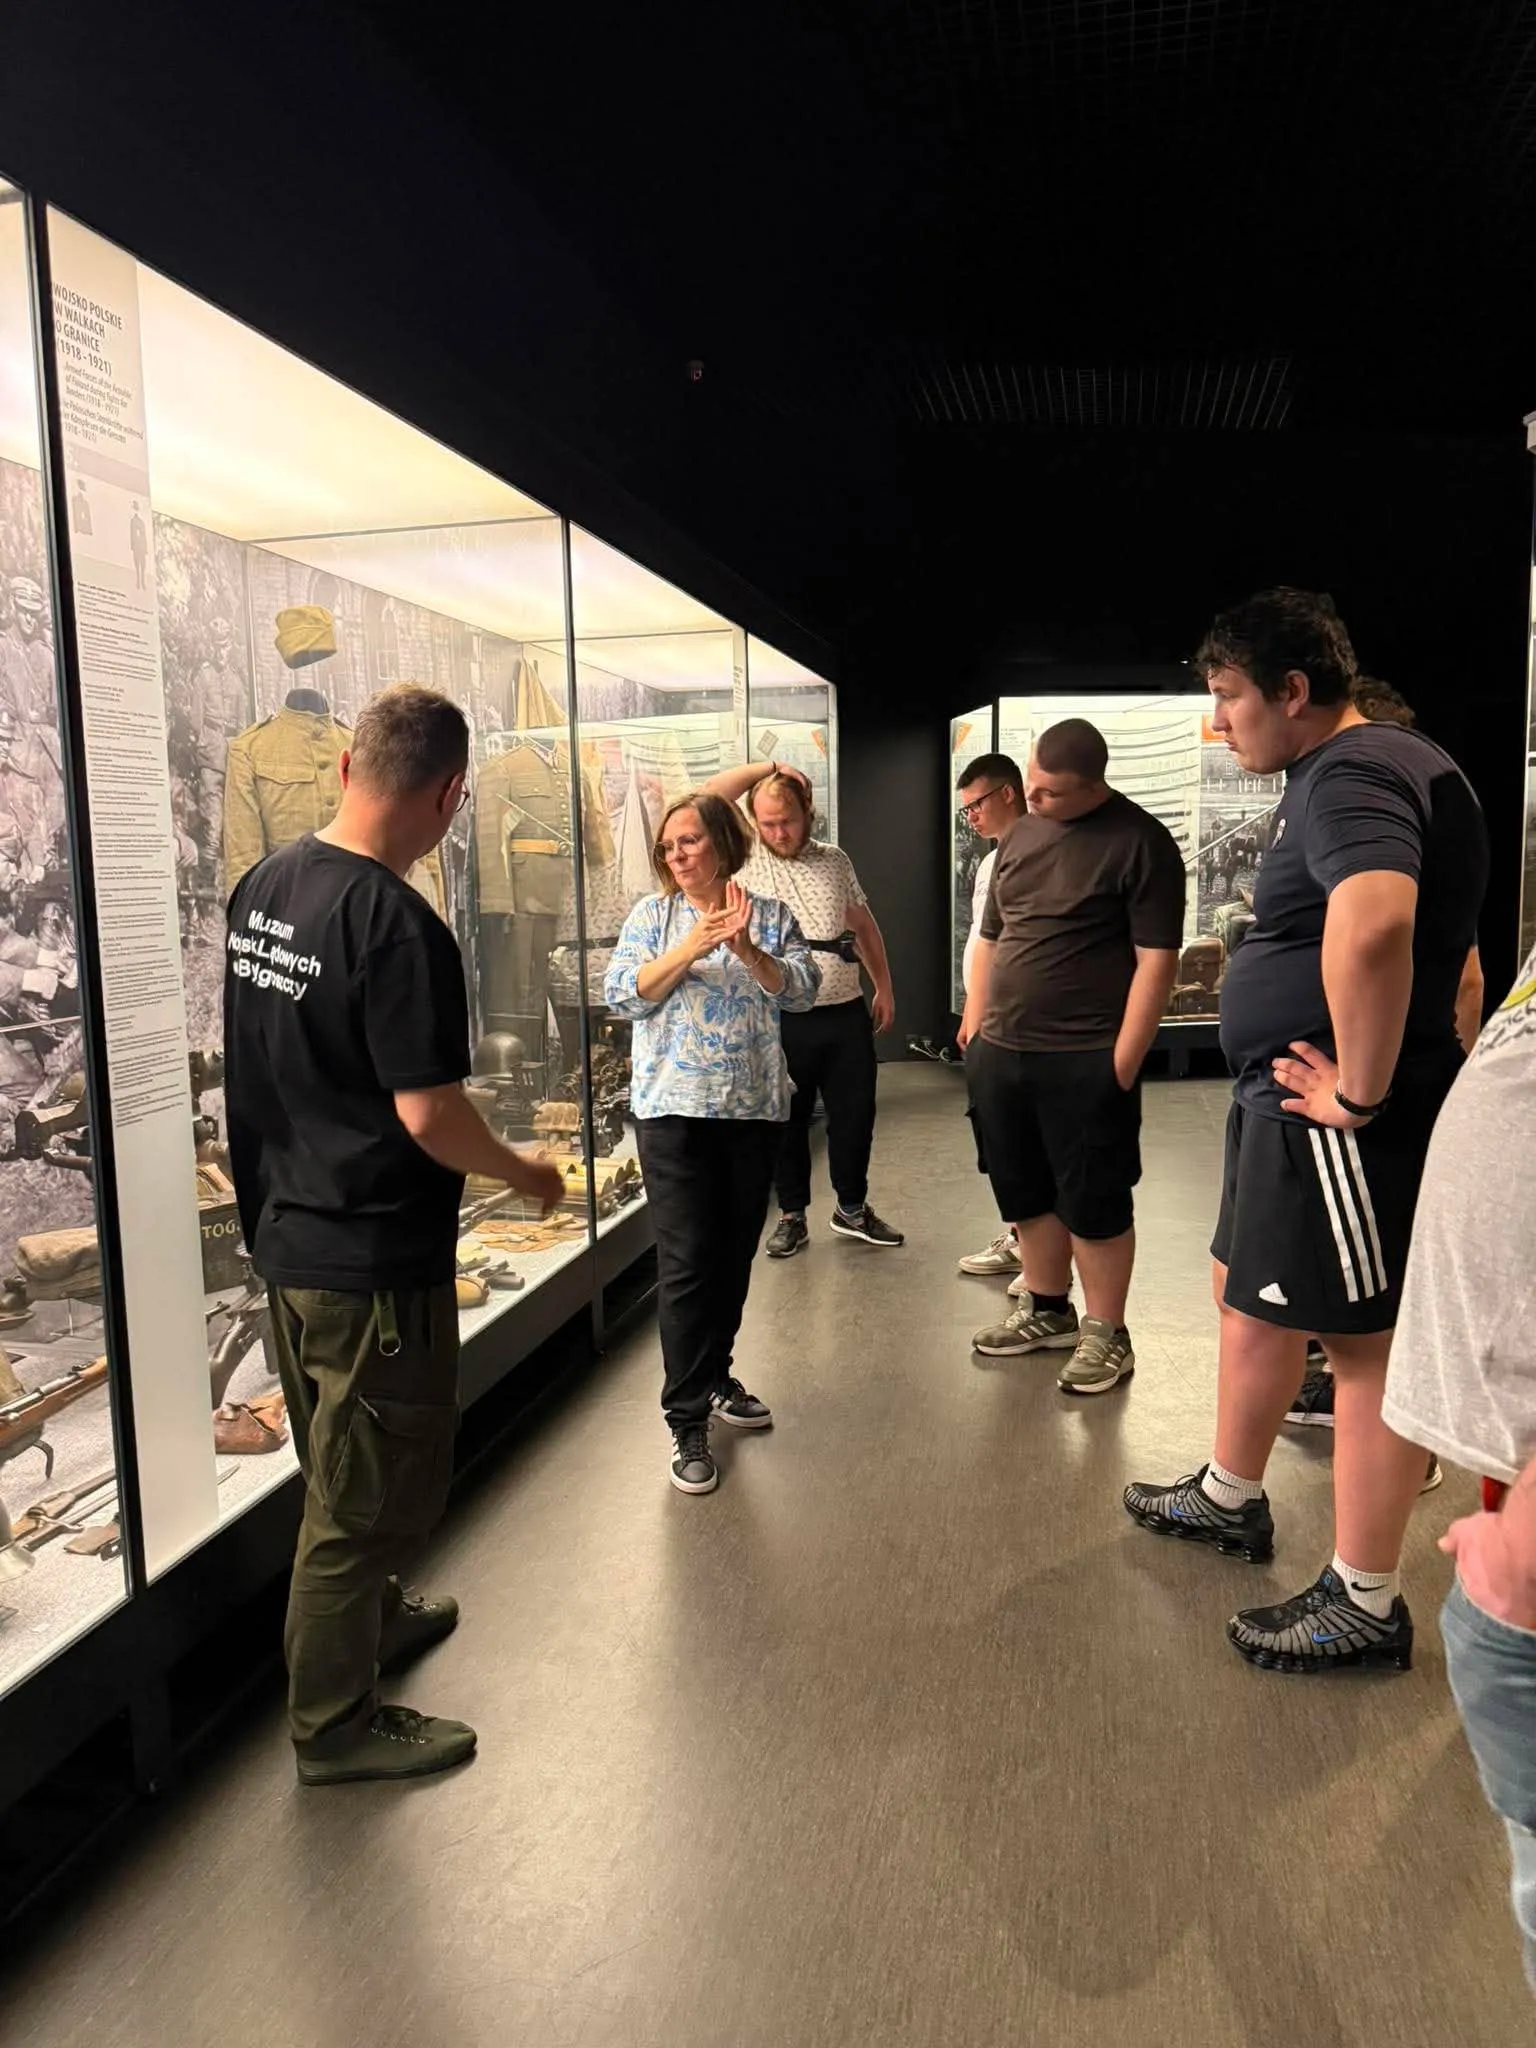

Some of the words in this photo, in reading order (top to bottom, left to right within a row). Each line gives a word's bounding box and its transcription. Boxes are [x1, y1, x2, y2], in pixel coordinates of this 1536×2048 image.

[54, 282, 87, 310] WOJSKO
[89, 302, 122, 330] POLSKIE
[54, 301, 63, 316] W
[64, 305, 105, 339] WALKACH
[63, 324, 100, 353] GRANICE
[88, 353, 112, 377] 1921)
